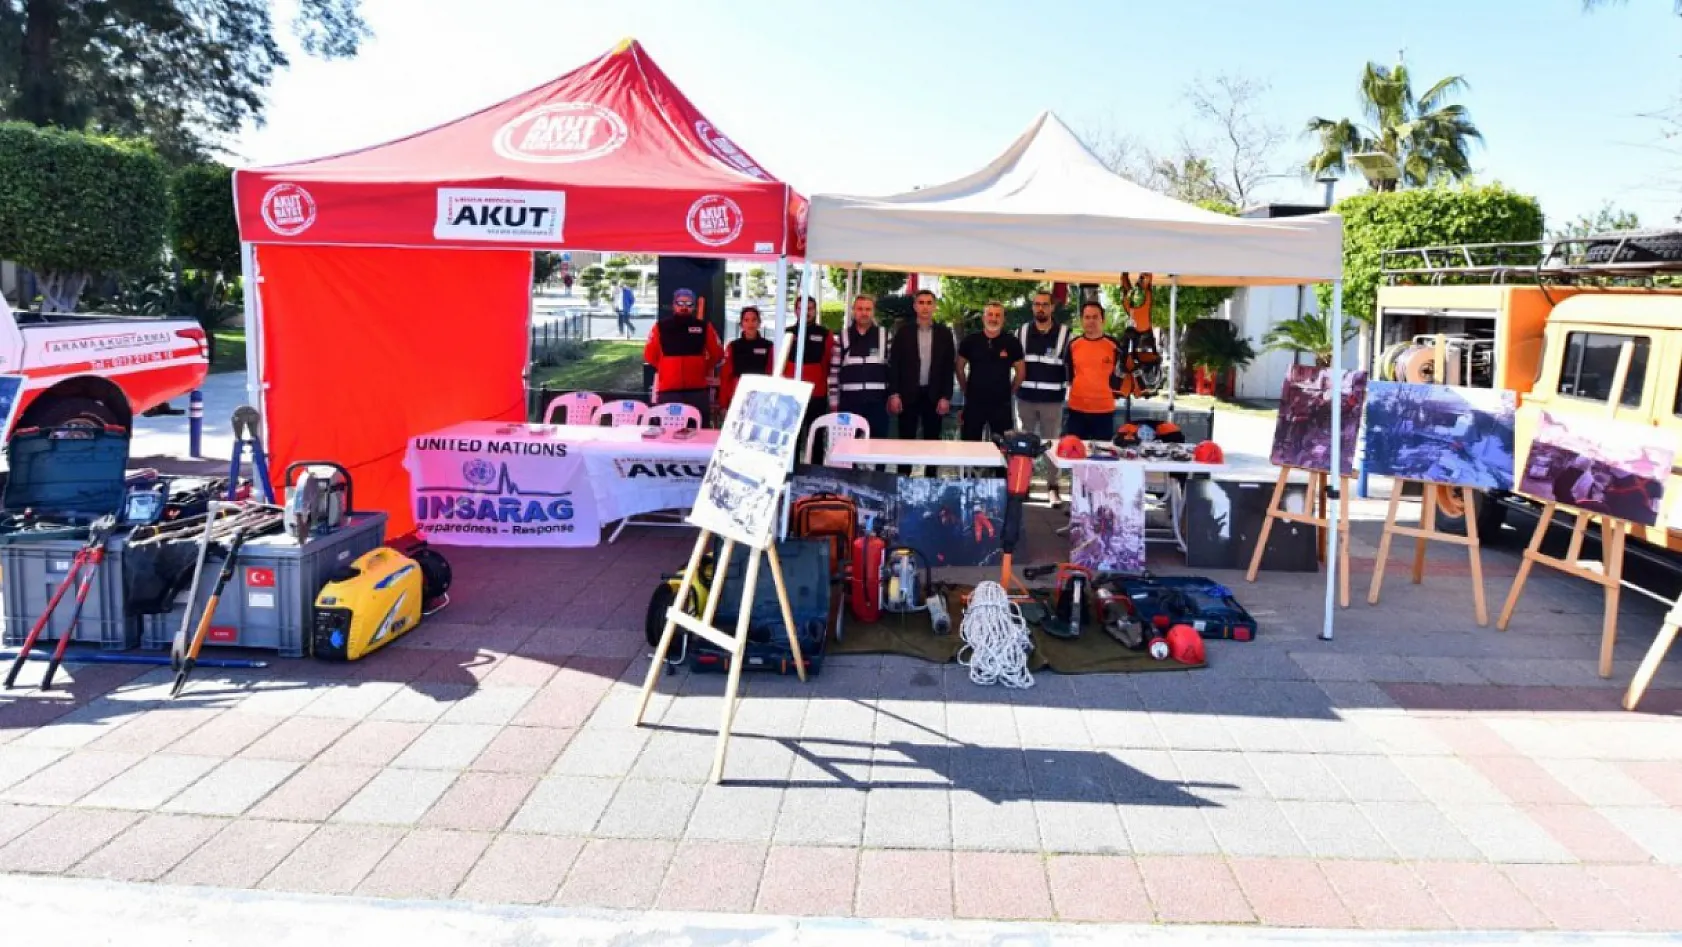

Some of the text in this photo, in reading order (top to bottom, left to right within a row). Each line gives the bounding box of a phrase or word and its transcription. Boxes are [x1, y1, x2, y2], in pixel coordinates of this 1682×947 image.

[452, 205, 549, 228] AKUT
[53, 339, 96, 352] ARAMA
[416, 438, 568, 457] UNITED NATIONS
[627, 463, 707, 478] AKU
[417, 496, 574, 523] INSARAG
[416, 522, 498, 534] Preparedness
[512, 523, 574, 536] Response
